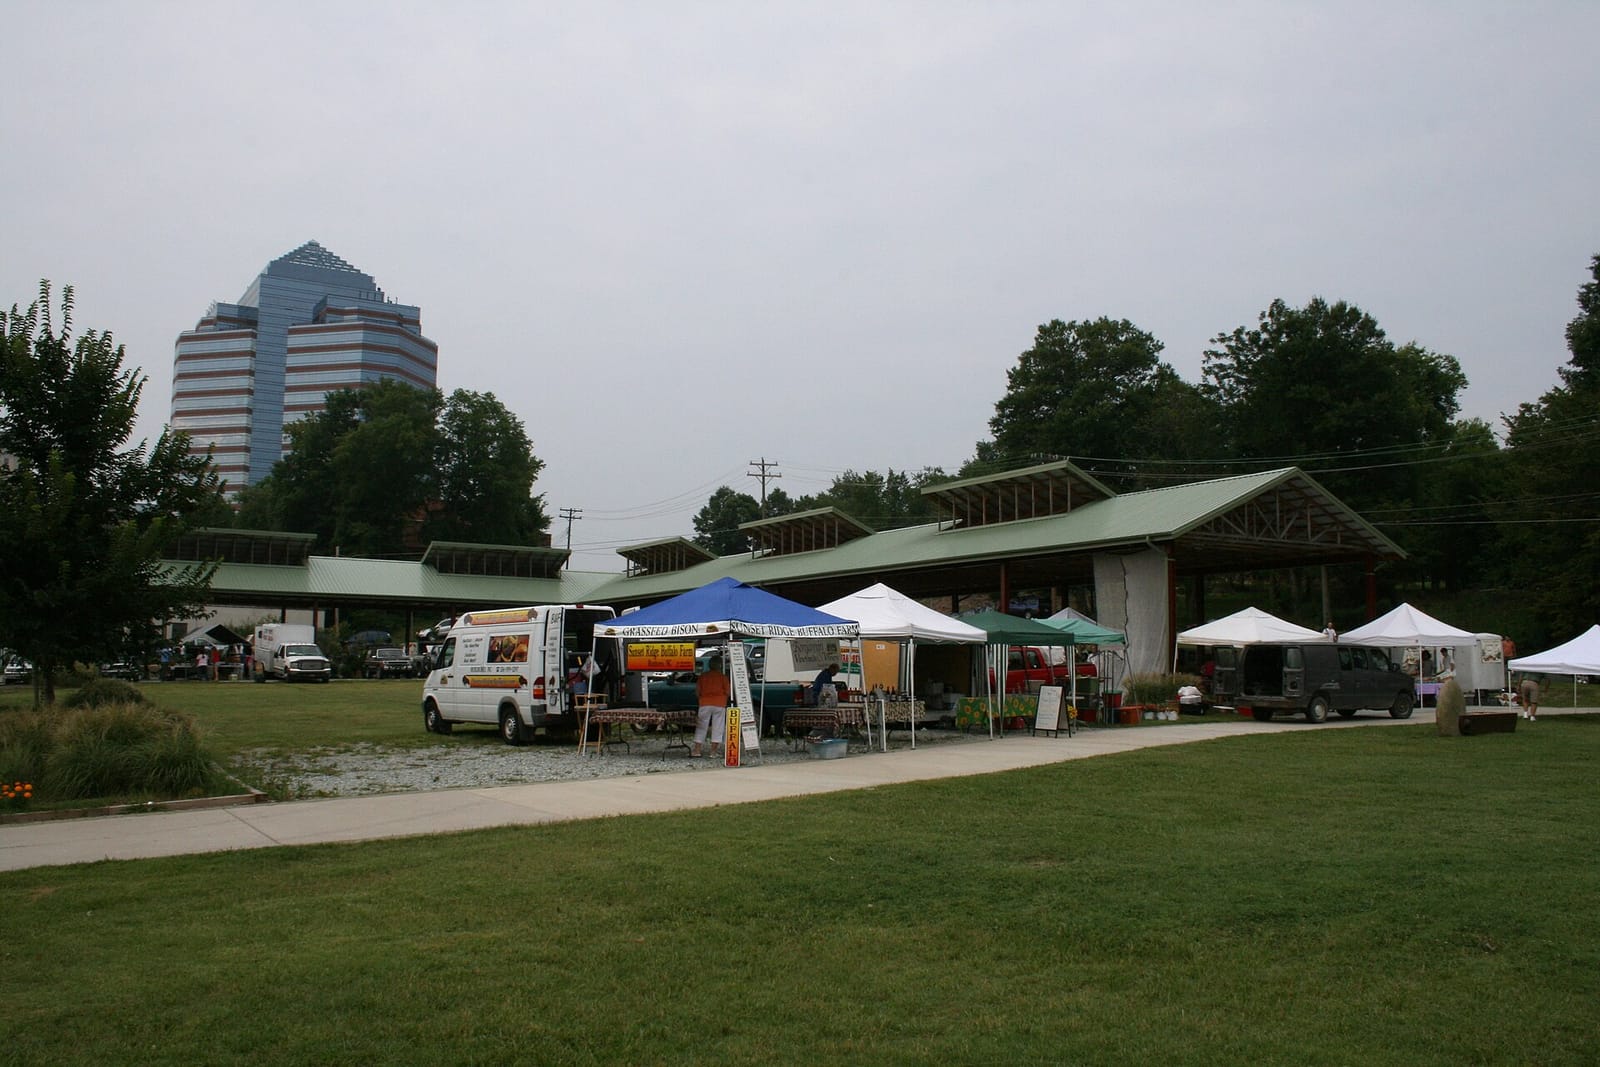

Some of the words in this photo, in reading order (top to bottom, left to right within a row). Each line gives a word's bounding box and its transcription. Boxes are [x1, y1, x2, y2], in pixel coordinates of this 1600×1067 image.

[622, 626, 668, 636] GRASSFED
[671, 624, 699, 635] BISON
[730, 621, 765, 634] SUNSET
[768, 624, 795, 636] RIDGE
[798, 626, 835, 636] BUFFALO
[837, 624, 859, 636] FARM
[679, 644, 693, 657] Farm
[729, 710, 738, 765] BUFFALO
